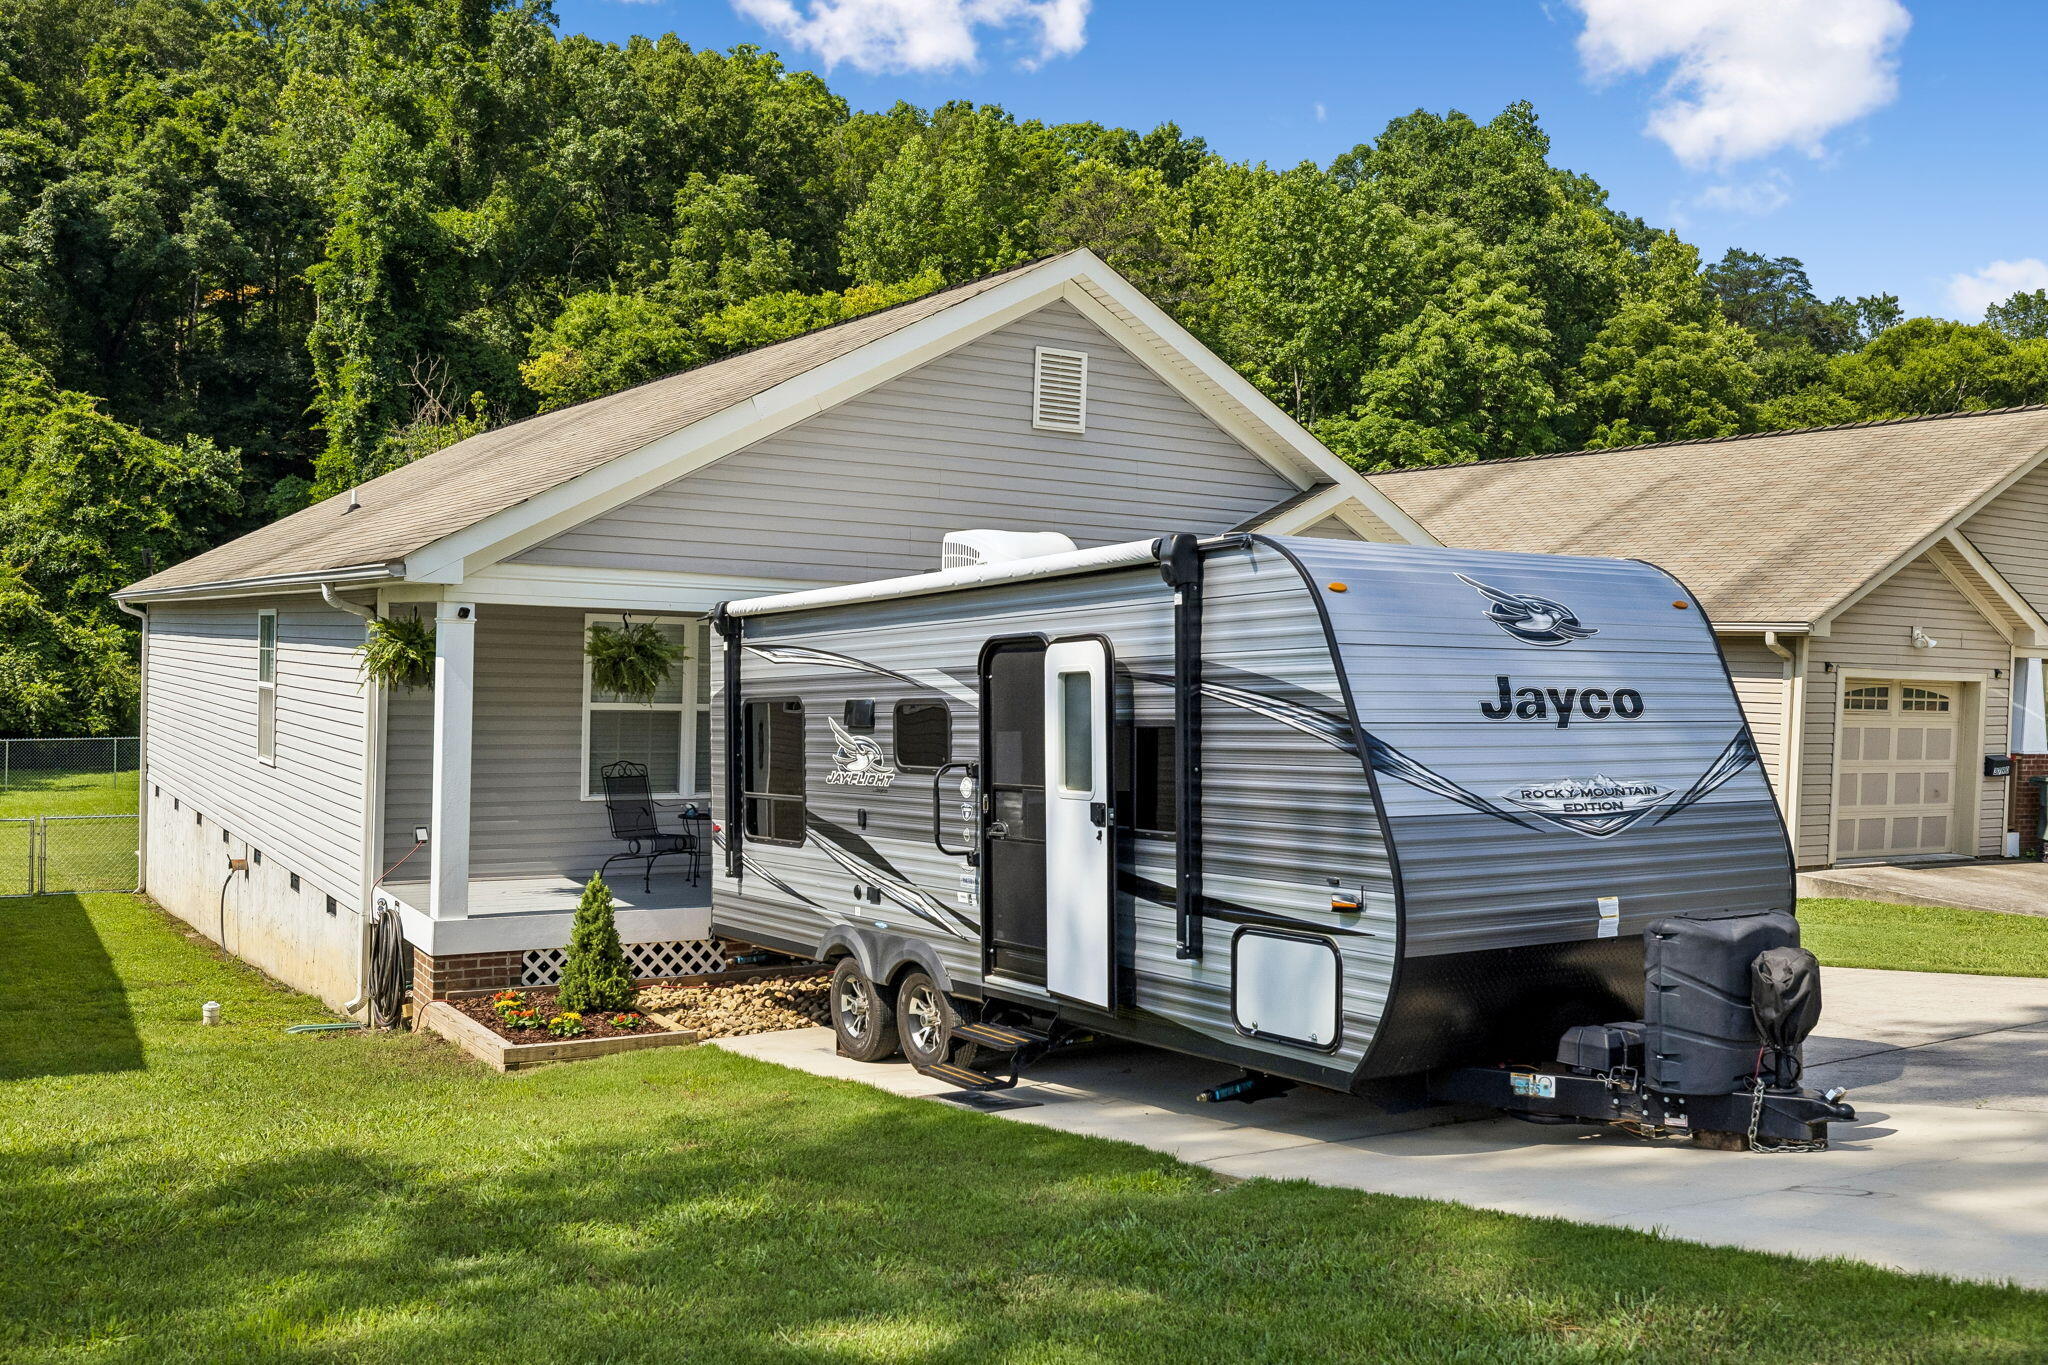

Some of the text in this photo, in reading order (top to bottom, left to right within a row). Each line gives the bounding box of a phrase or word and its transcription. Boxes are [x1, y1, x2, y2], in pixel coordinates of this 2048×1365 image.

[1479, 674, 1646, 730] Jayco
[849, 772, 895, 787] FLIGHT
[1520, 785, 1658, 800] ROCKY MOUNTAIN
[1562, 801, 1624, 813] EDITION
